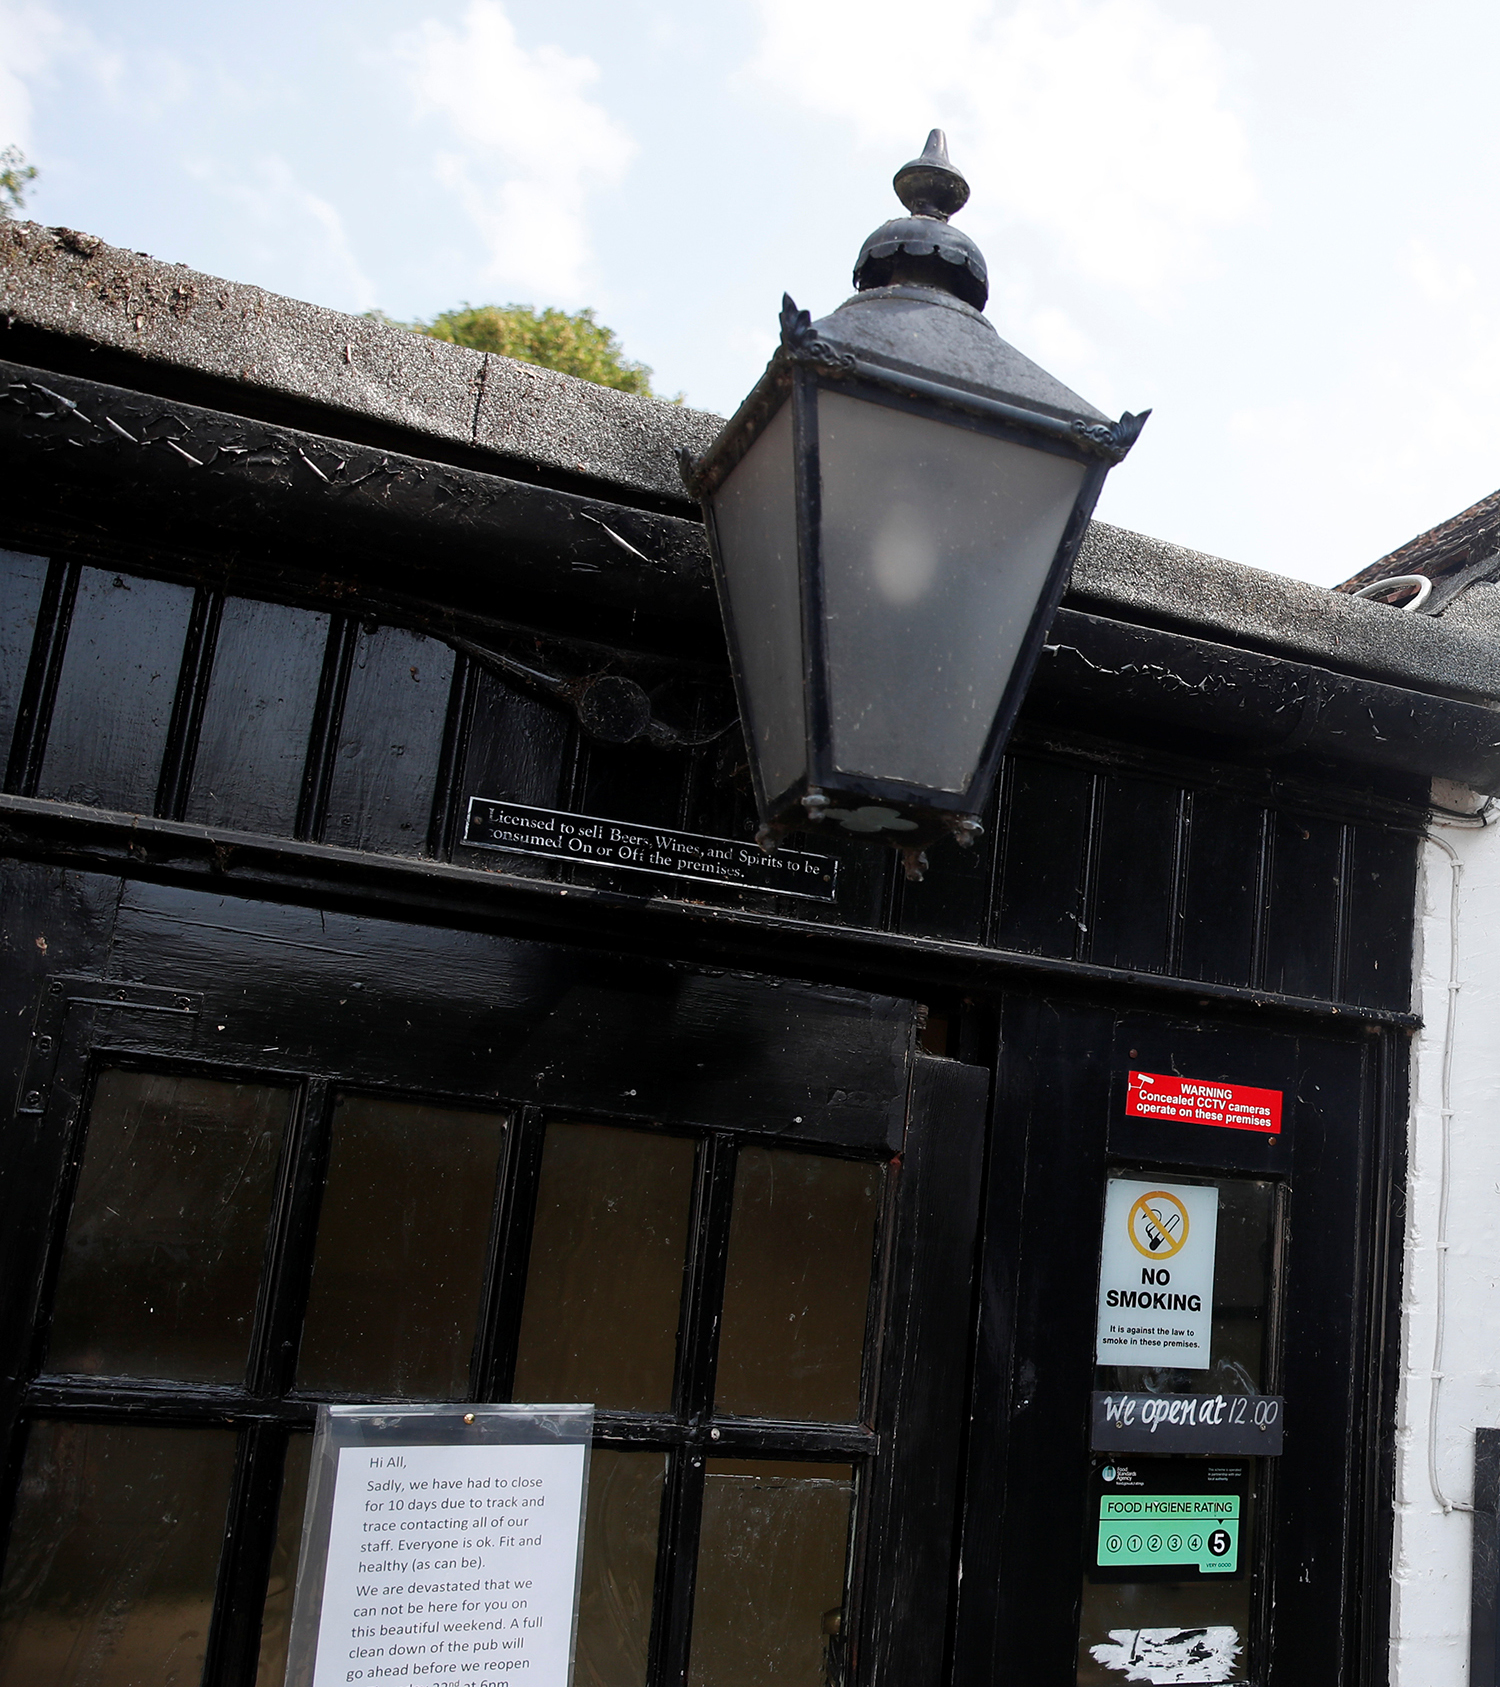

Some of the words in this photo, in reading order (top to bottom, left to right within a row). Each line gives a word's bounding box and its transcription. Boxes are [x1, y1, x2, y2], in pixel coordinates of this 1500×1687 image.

[489, 808, 555, 831] Licensed
[561, 823, 574, 834] to
[655, 836, 704, 857] Wines,
[707, 849, 732, 860] and
[739, 850, 782, 868] Spirits
[787, 861, 800, 871] to
[805, 861, 820, 874] be
[568, 838, 592, 853] On
[596, 846, 612, 856] or
[650, 852, 672, 865] the
[678, 858, 744, 878] premises.
[1181, 1083, 1232, 1099] WARNING
[1139, 1090, 1194, 1106] Concealed
[1197, 1098, 1226, 1109] CCTV
[1228, 1102, 1270, 1116] cameras
[1137, 1103, 1176, 1115] operate
[1179, 1108, 1192, 1117] on
[1195, 1109, 1223, 1121] these
[1226, 1113, 1271, 1127] premises
[1142, 1268, 1170, 1286] NO
[1106, 1290, 1201, 1311] SMOKING
[1118, 1325, 1124, 1333] is
[1127, 1327, 1155, 1335] against
[1142, 1399, 1197, 1432] open
[1199, 1395, 1227, 1425] at
[370, 1457, 383, 1468] Hi
[387, 1456, 407, 1470] All,
[367, 1480, 405, 1494] Sadly,
[409, 1481, 428, 1490] we
[432, 1478, 463, 1489] have
[467, 1477, 491, 1488] had
[495, 1479, 508, 1488] to
[511, 1477, 543, 1488] close
[365, 1500, 383, 1512] for
[388, 1500, 404, 1511] 10
[407, 1499, 437, 1513] days
[441, 1498, 465, 1509] due
[469, 1499, 482, 1508] to
[486, 1497, 518, 1507] track
[522, 1496, 545, 1507] and
[1108, 1502, 1142, 1513] FOOD
[1145, 1502, 1191, 1512] HYGIENE
[1194, 1502, 1232, 1512] RATING
[363, 1522, 396, 1532] trace
[400, 1518, 468, 1531] contacting
[472, 1517, 487, 1528] all
[491, 1516, 505, 1527] of
[508, 1518, 529, 1527] our
[360, 1540, 394, 1553] staff.
[398, 1539, 458, 1552] Everyone
[462, 1538, 472, 1548] is
[476, 1537, 495, 1547] ok.
[500, 1536, 515, 1547] Fit
[519, 1535, 542, 1546] and
[1111, 1539, 1117, 1548] 0
[1152, 1539, 1157, 1548] 2
[1172, 1538, 1178, 1548] 3
[1191, 1538, 1198, 1547] 4
[1213, 1534, 1225, 1553] 5
[358, 1559, 408, 1573] healthy
[412, 1558, 431, 1571] (as
[434, 1560, 457, 1569] can
[461, 1556, 486, 1569] be).
[356, 1585, 379, 1596] We
[383, 1586, 404, 1595] are
[407, 1580, 480, 1594] devastated
[484, 1579, 510, 1590] that
[514, 1580, 532, 1588] we
[353, 1608, 376, 1617] can
[381, 1605, 403, 1616] not
[407, 1603, 423, 1614] be
[428, 1602, 458, 1613] here
[461, 1600, 480, 1611] for
[484, 1601, 508, 1612] you
[512, 1600, 527, 1609] on
[351, 1626, 375, 1638] this
[380, 1622, 439, 1636] beautiful
[443, 1620, 506, 1632] weekend.
[510, 1619, 519, 1628] A
[523, 1617, 543, 1628] full
[349, 1647, 384, 1659] clean
[388, 1644, 427, 1656] down
[430, 1642, 445, 1654] of
[448, 1642, 469, 1653] the
[473, 1640, 498, 1654] pub
[502, 1638, 524, 1650] will
[346, 1669, 363, 1682] go
[367, 1665, 409, 1677] ahead
[413, 1662, 456, 1675] before
[461, 1662, 480, 1671] we
[484, 1658, 530, 1672] reopen
